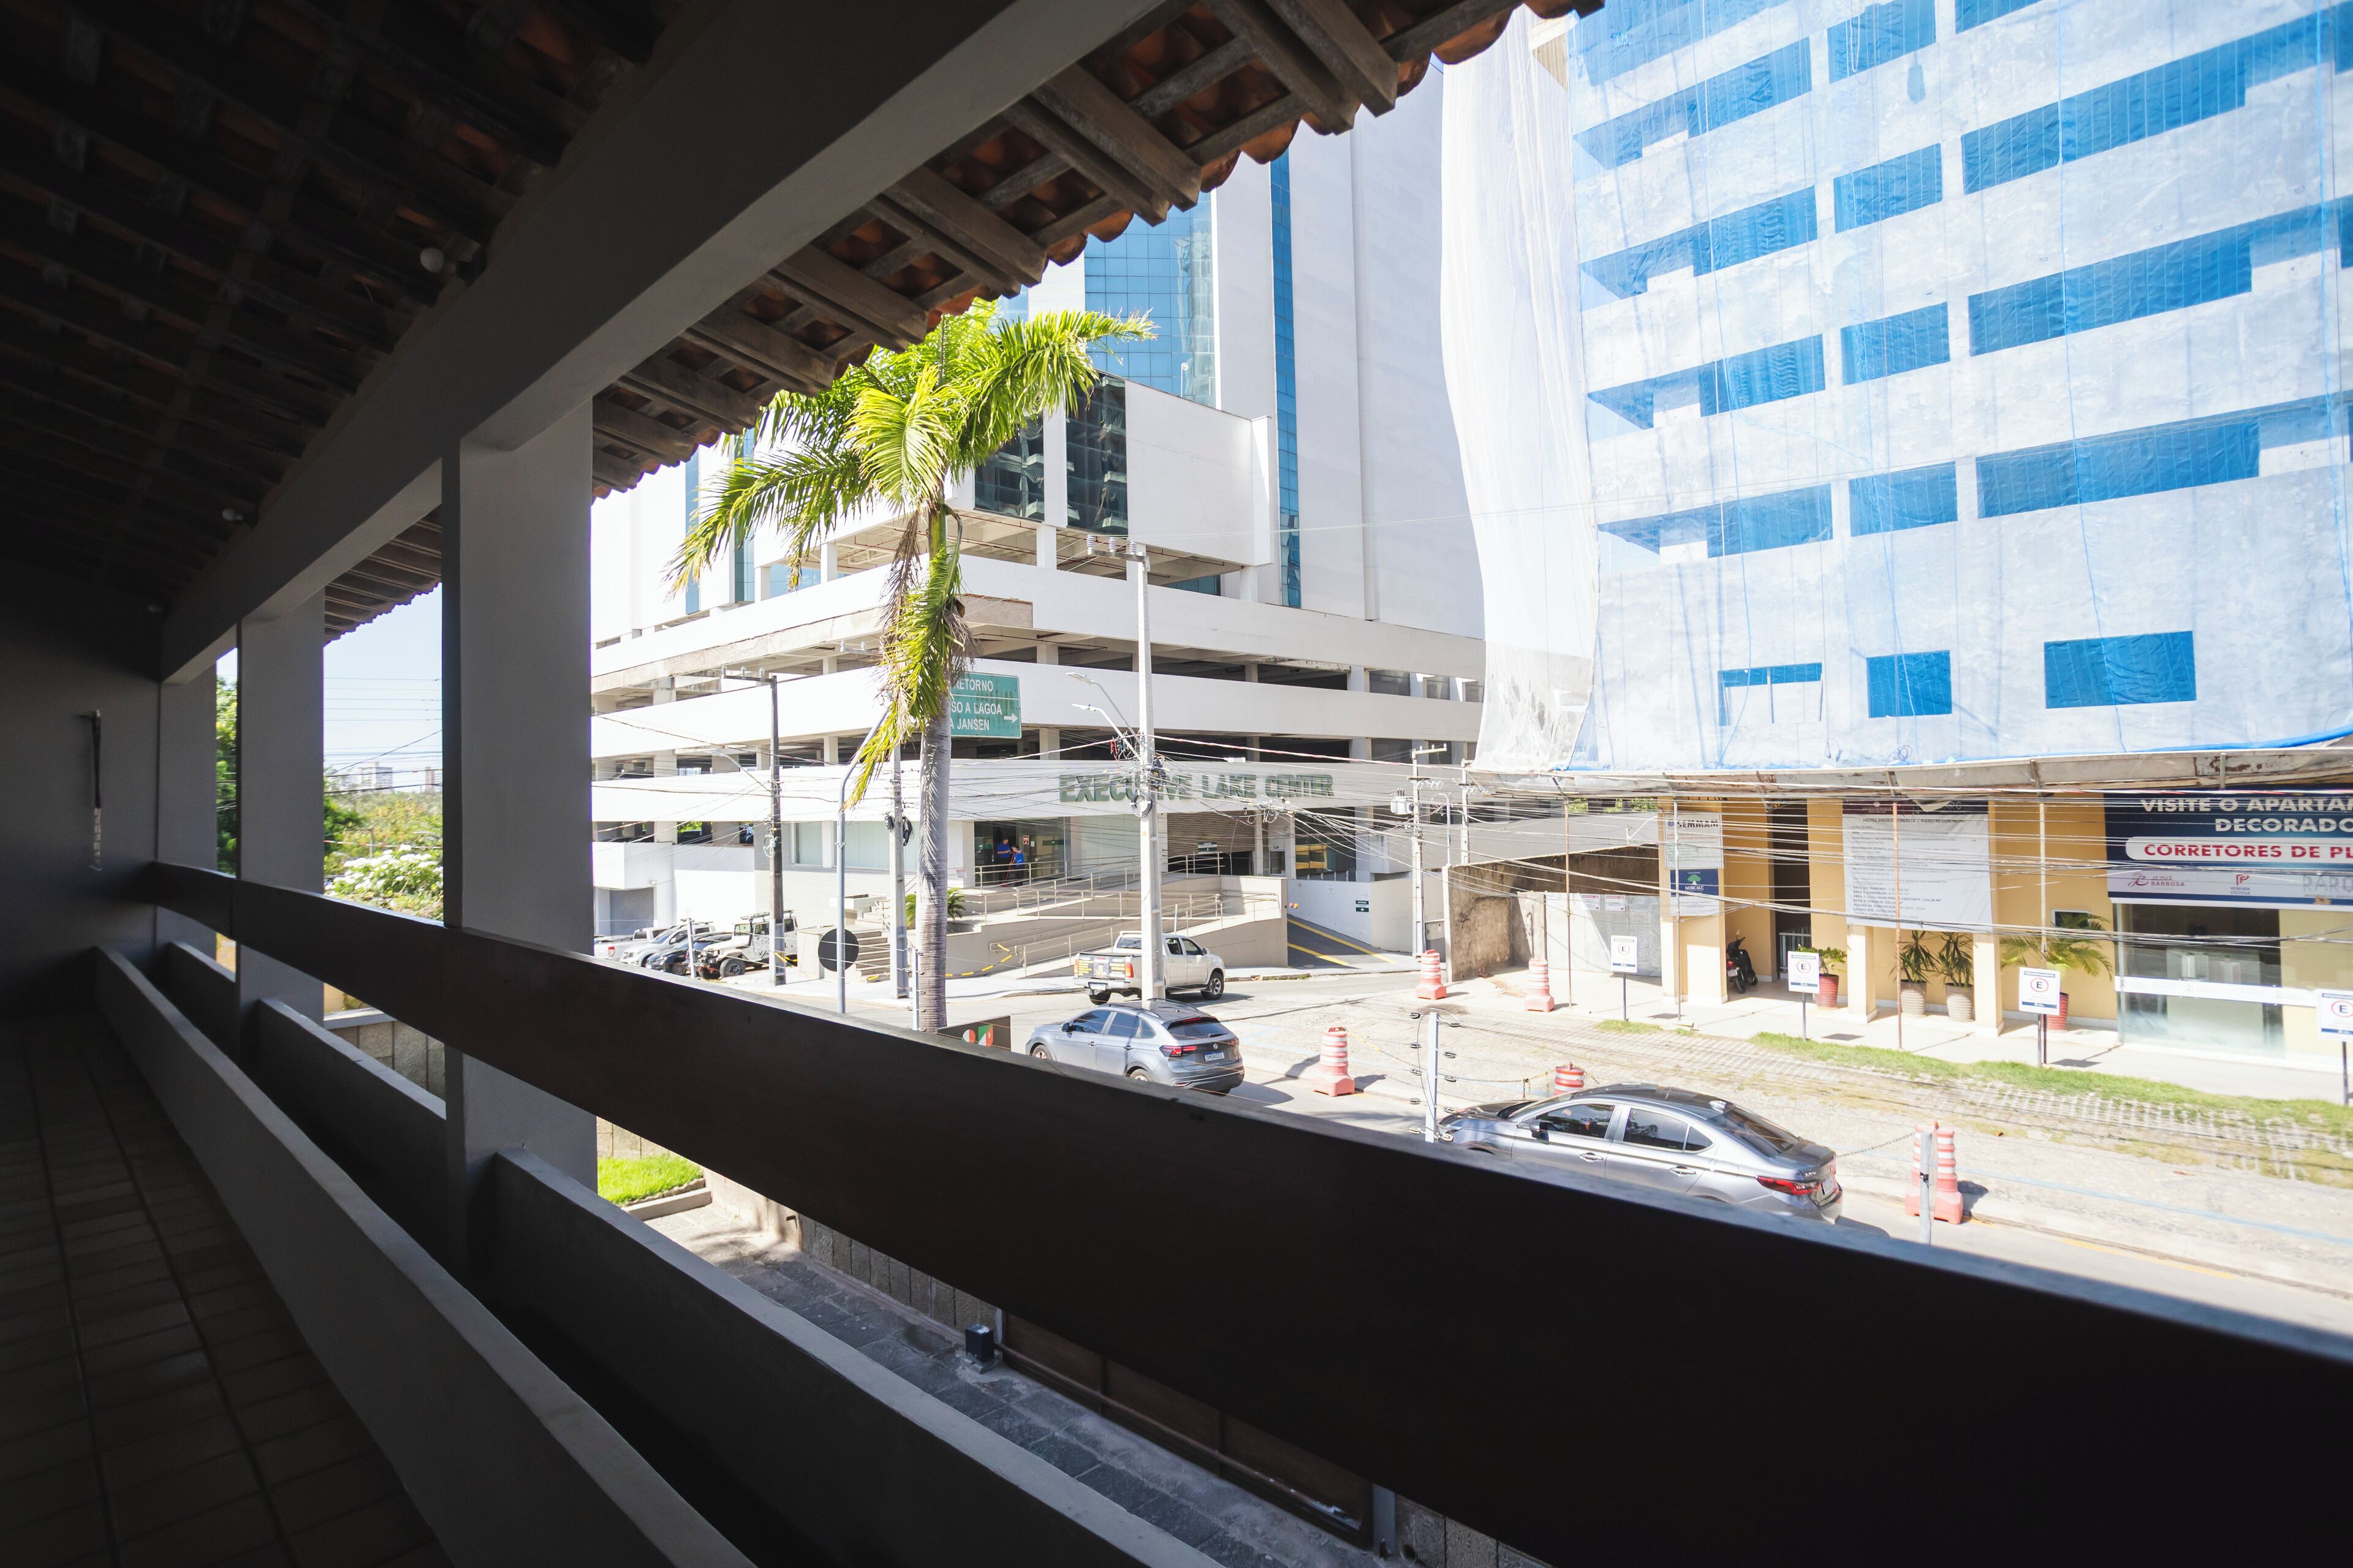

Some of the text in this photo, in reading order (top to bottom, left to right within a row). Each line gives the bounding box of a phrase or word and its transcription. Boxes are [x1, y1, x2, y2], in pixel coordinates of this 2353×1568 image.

[953, 678, 993, 692] RETORNO
[965, 703, 971, 714] A
[974, 702, 1002, 716] LAGOA
[957, 718, 990, 730] JANSEN
[1202, 774, 1257, 798] LAKE
[1265, 775, 1335, 797] CENTER
[2140, 798, 2211, 812] VISITE
[2219, 798, 2239, 812] O
[2144, 844, 2282, 858] CORRETORES
[2291, 846, 2320, 858] DE
[2340, 1005, 2348, 1013] E
